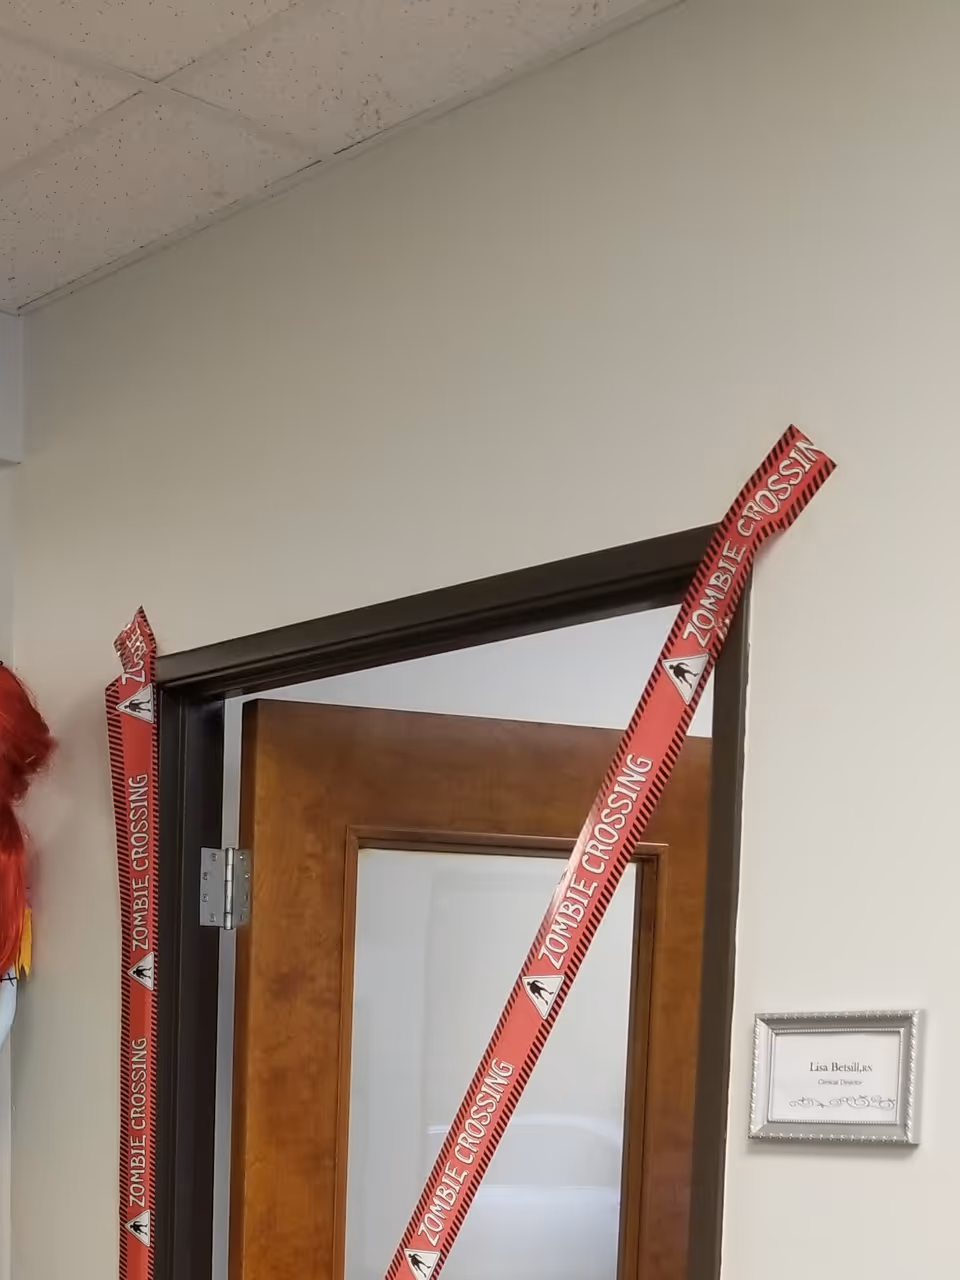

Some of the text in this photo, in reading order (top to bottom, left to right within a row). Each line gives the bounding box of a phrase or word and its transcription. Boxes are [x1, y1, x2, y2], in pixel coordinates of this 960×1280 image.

[682, 538, 747, 648] ZOMBIE
[129, 773, 150, 952] ZOMBIE CROSSING
[538, 753, 653, 970] ZOMBIE CROSSING
[129, 1037, 148, 1207] ZOMBIE CROSSING
[417, 1057, 515, 1247] ZOMBIE CROSSING
[810, 1061, 828, 1072] Lisa
